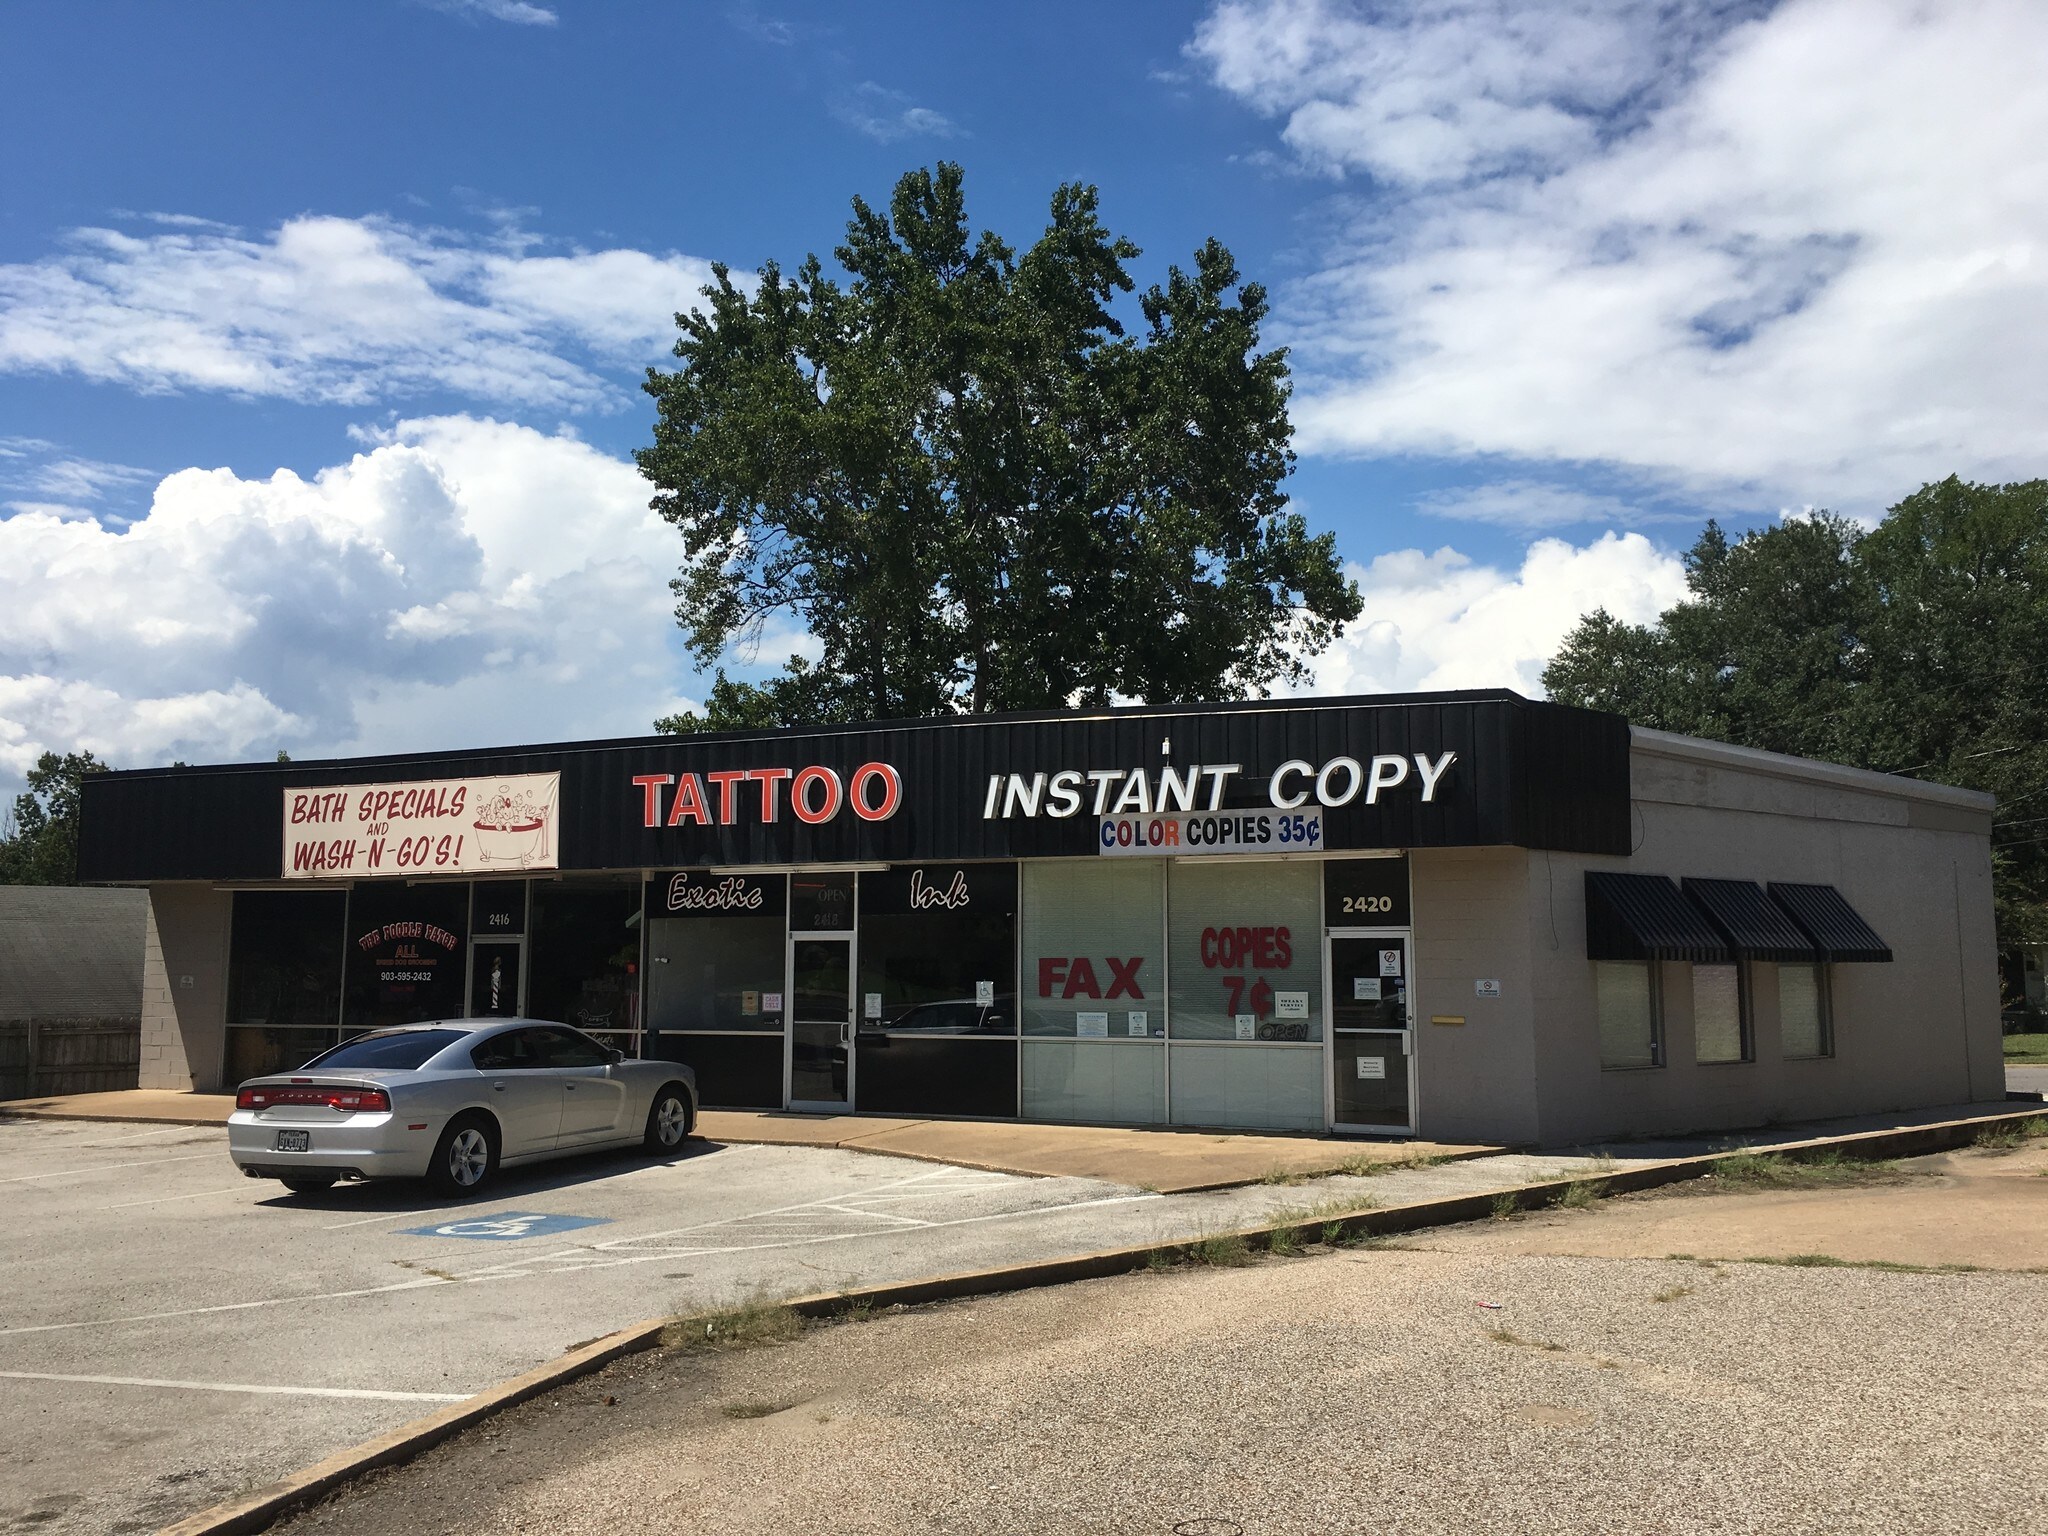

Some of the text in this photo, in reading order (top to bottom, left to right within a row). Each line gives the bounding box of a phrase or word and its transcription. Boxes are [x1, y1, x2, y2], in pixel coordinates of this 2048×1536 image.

[632, 762, 903, 827] TATTOO
[983, 751, 1456, 819] INSTANT COPY
[291, 786, 468, 824] BATH SPECIALS
[366, 822, 389, 837] AND
[1100, 815, 1320, 847] COLOR COPIES 35¢
[667, 872, 763, 910] Exotic
[818, 889, 848, 902] OPEN
[909, 869, 970, 910] Ink
[1342, 896, 1392, 912] 2420
[489, 913, 510, 925] 2416
[358, 921, 458, 951] THE POODLE PATCH
[395, 944, 419, 958] ALL
[1200, 926, 1292, 969] COPIES
[380, 971, 432, 981] 903-595-2432
[1039, 957, 1145, 999] FAX
[1258, 1023, 1308, 1040] OPEN
